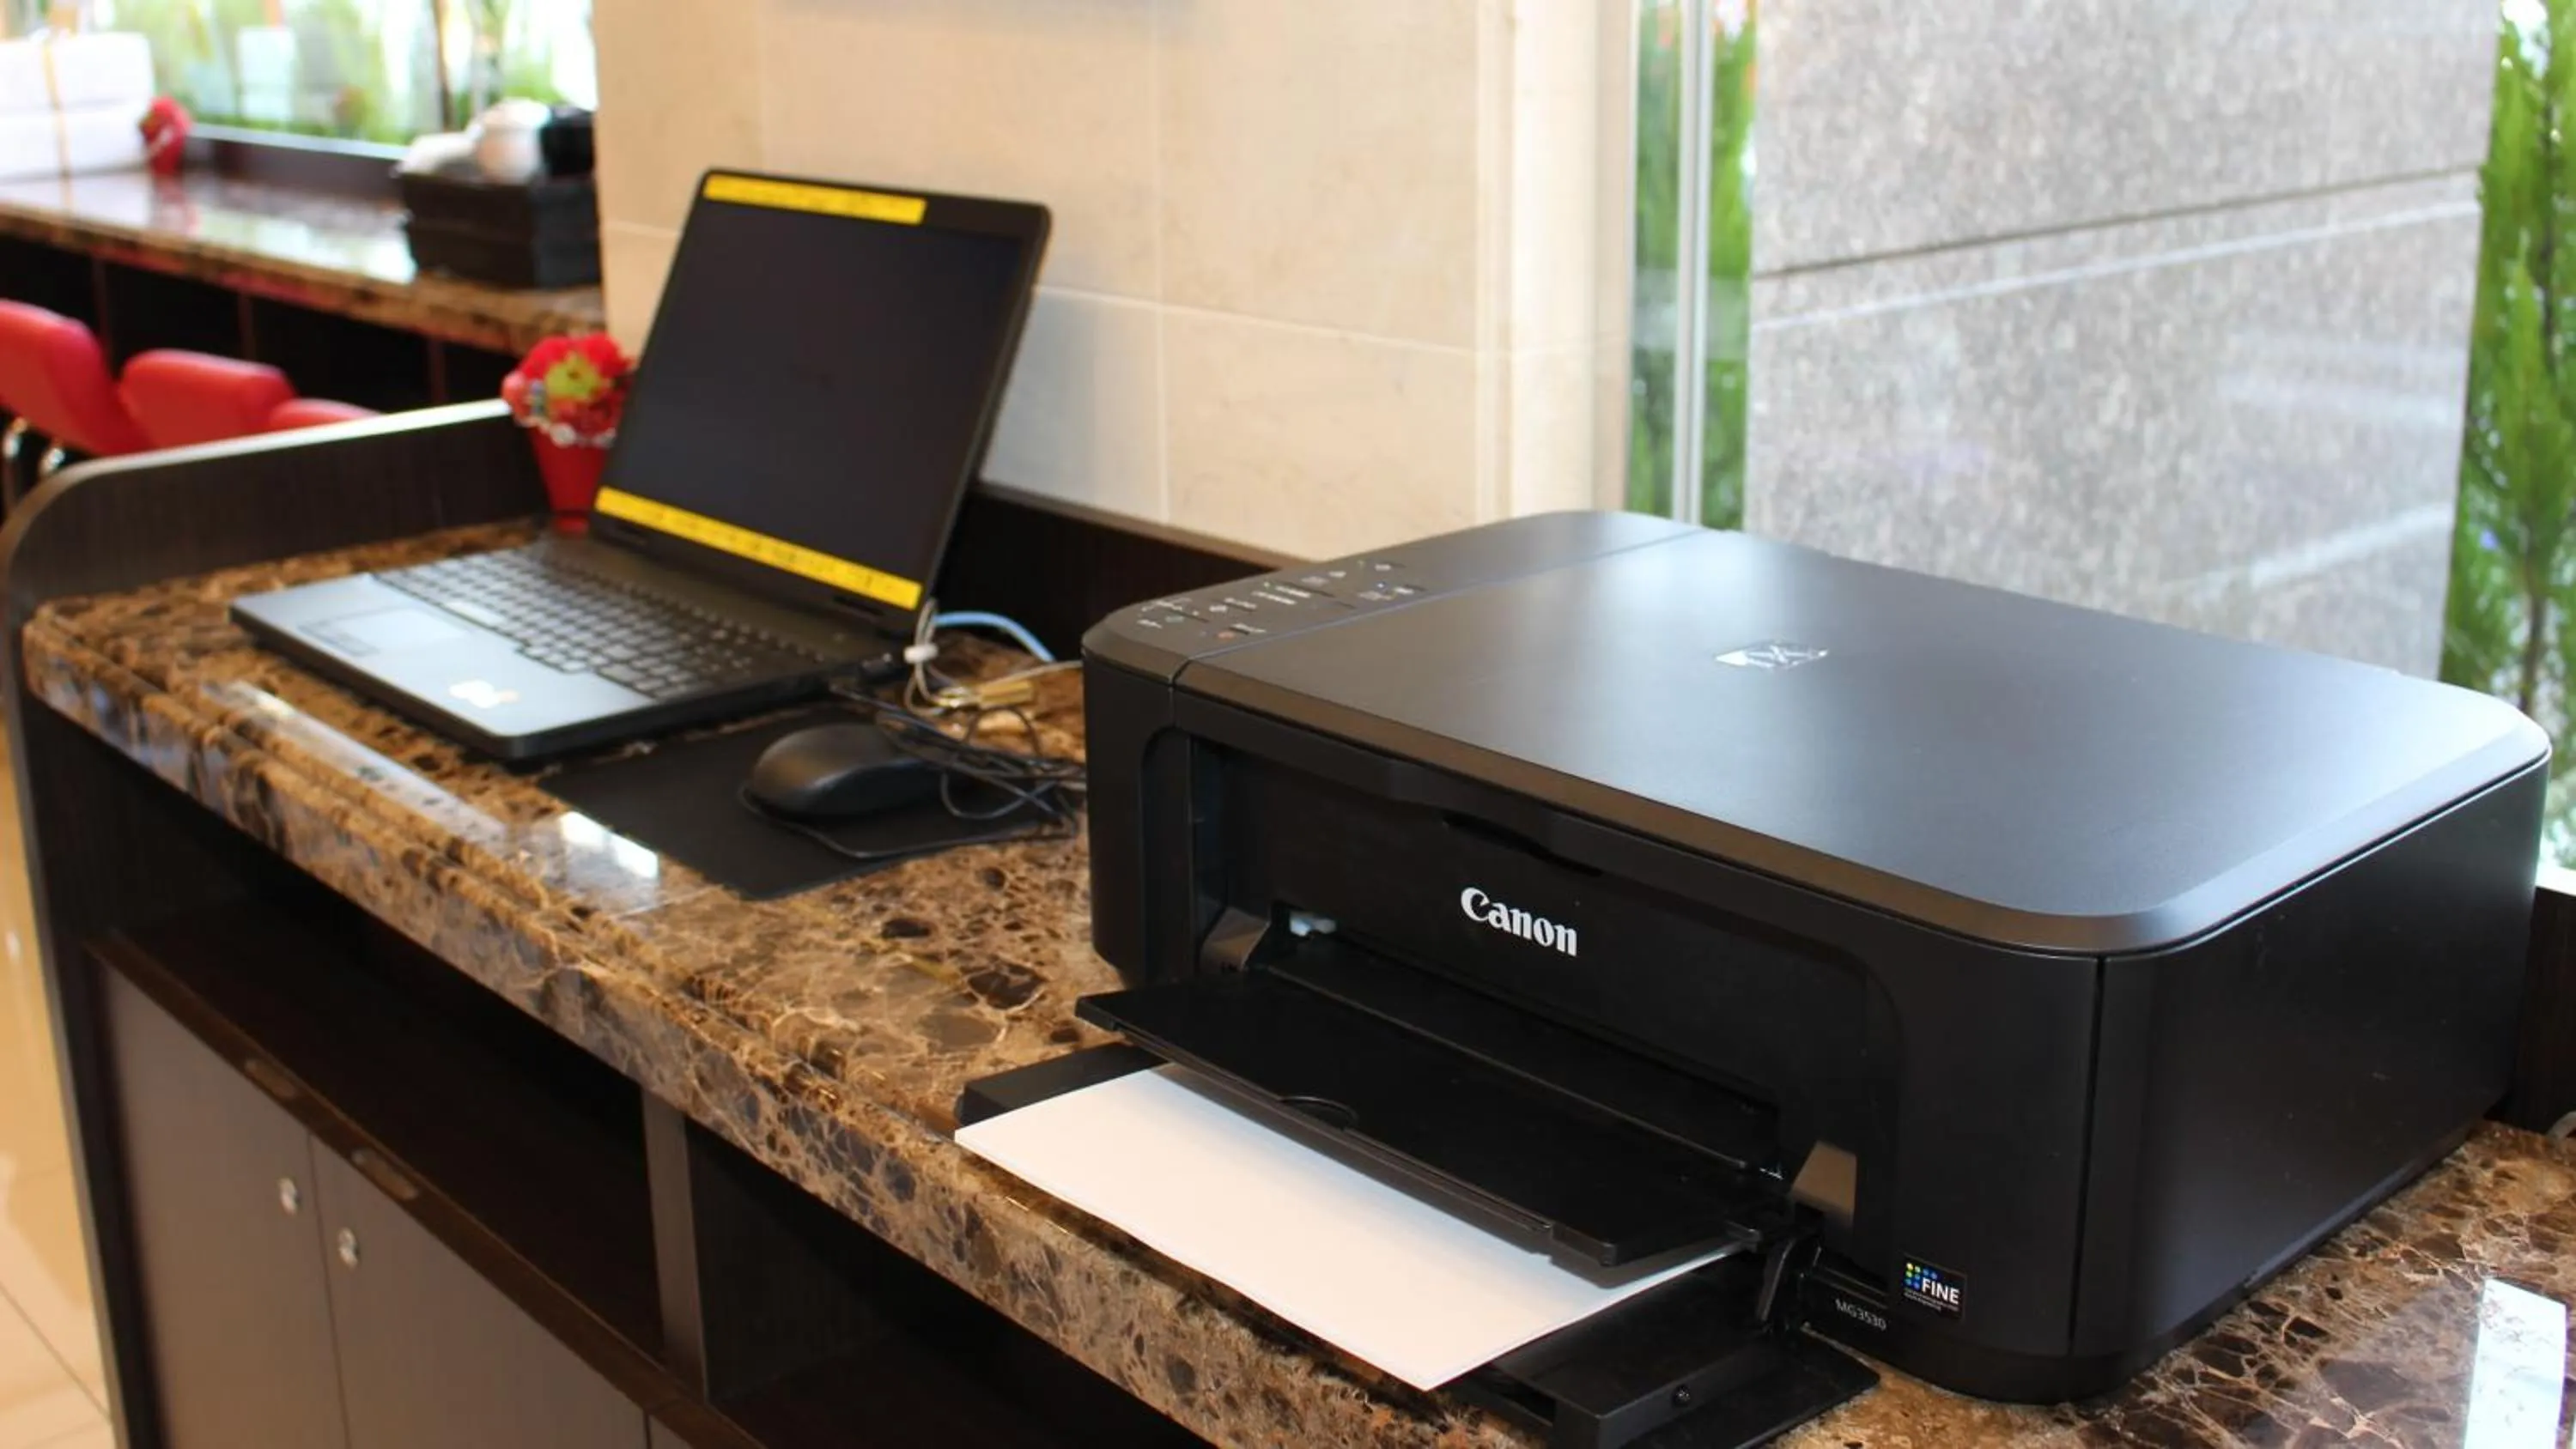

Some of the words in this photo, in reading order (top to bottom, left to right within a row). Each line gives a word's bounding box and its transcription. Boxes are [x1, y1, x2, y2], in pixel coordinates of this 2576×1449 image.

[1461, 887, 1577, 957] Canon
[1922, 1277, 1959, 1305] FINE
[1835, 1298, 1886, 1331] MG3530
